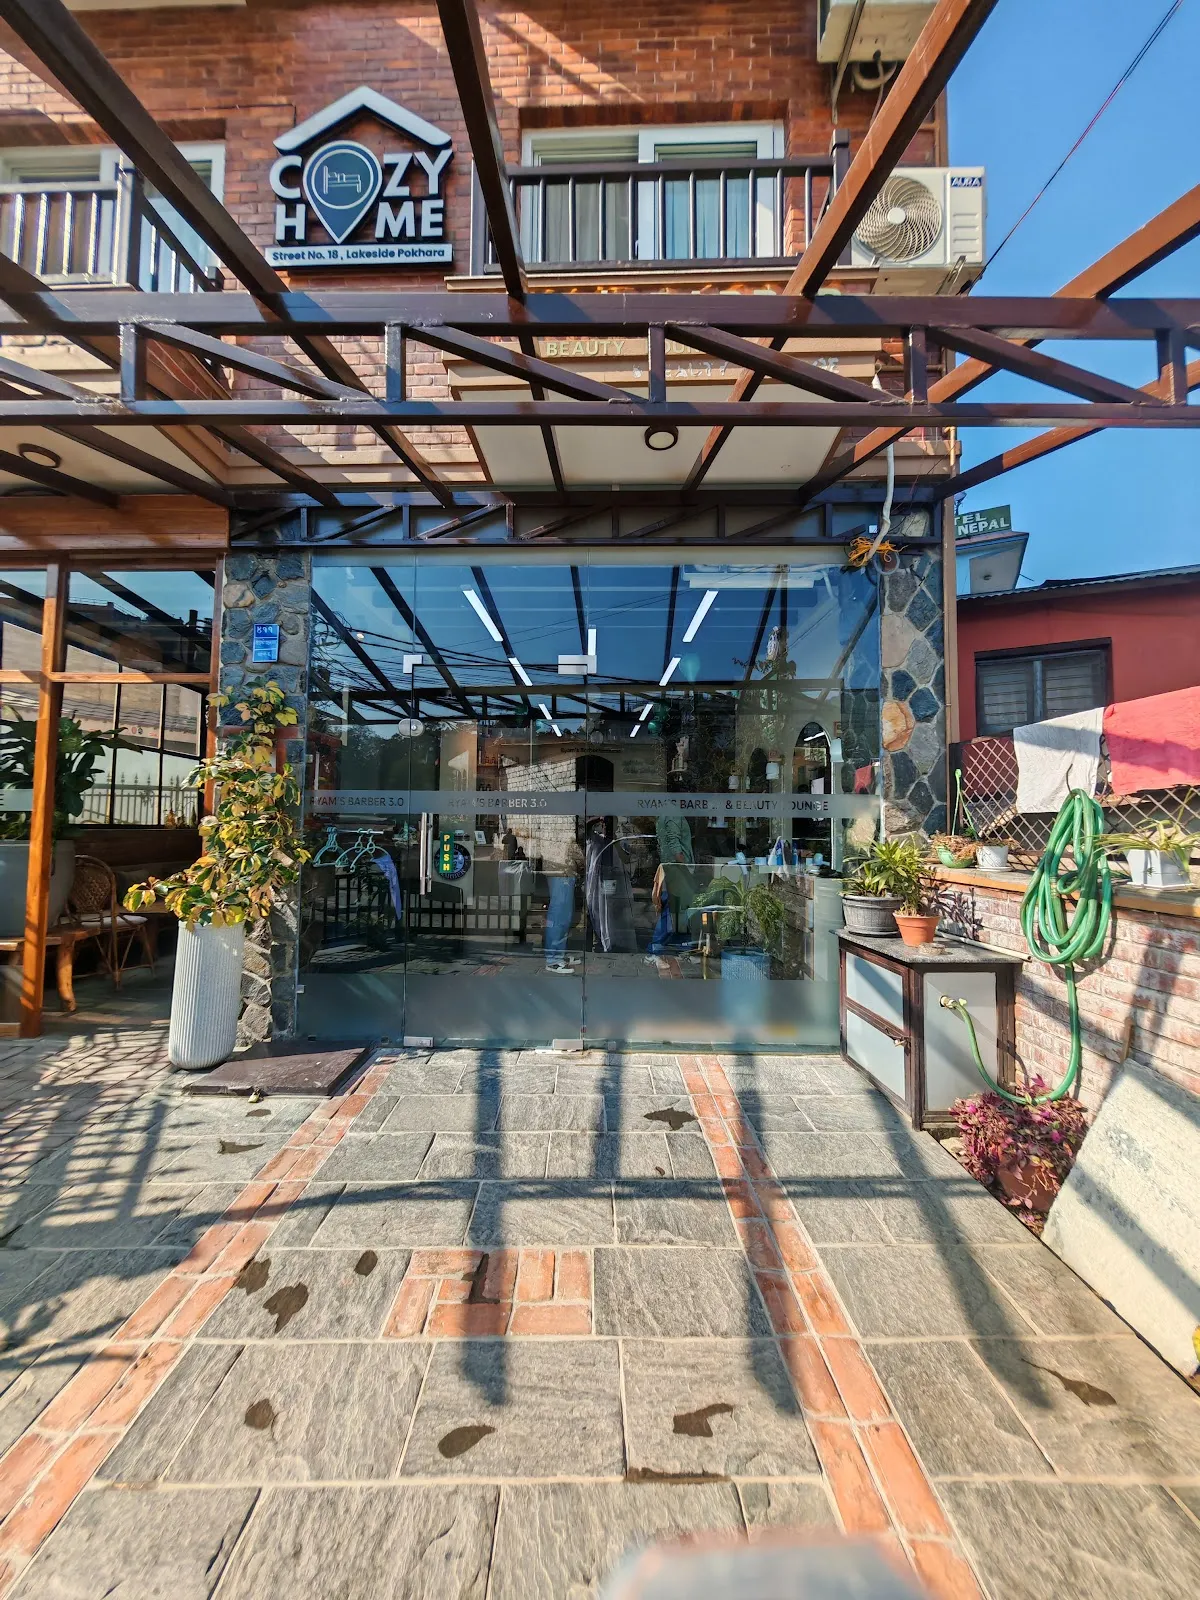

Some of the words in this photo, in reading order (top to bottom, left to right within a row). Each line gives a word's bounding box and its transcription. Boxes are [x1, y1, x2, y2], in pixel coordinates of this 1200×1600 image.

[272, 251, 305, 261] Street
[308, 251, 325, 260] No.
[346, 248, 395, 259] Lakeside
[398, 248, 445, 258] Pokhara
[546, 340, 625, 356] BEAUTY
[957, 518, 1009, 535] NEPAL
[348, 797, 386, 806] BARBER
[388, 797, 404, 806] 3.0
[487, 798, 528, 808] BARBER
[530, 798, 547, 808] 3.0
[725, 800, 733, 809] &
